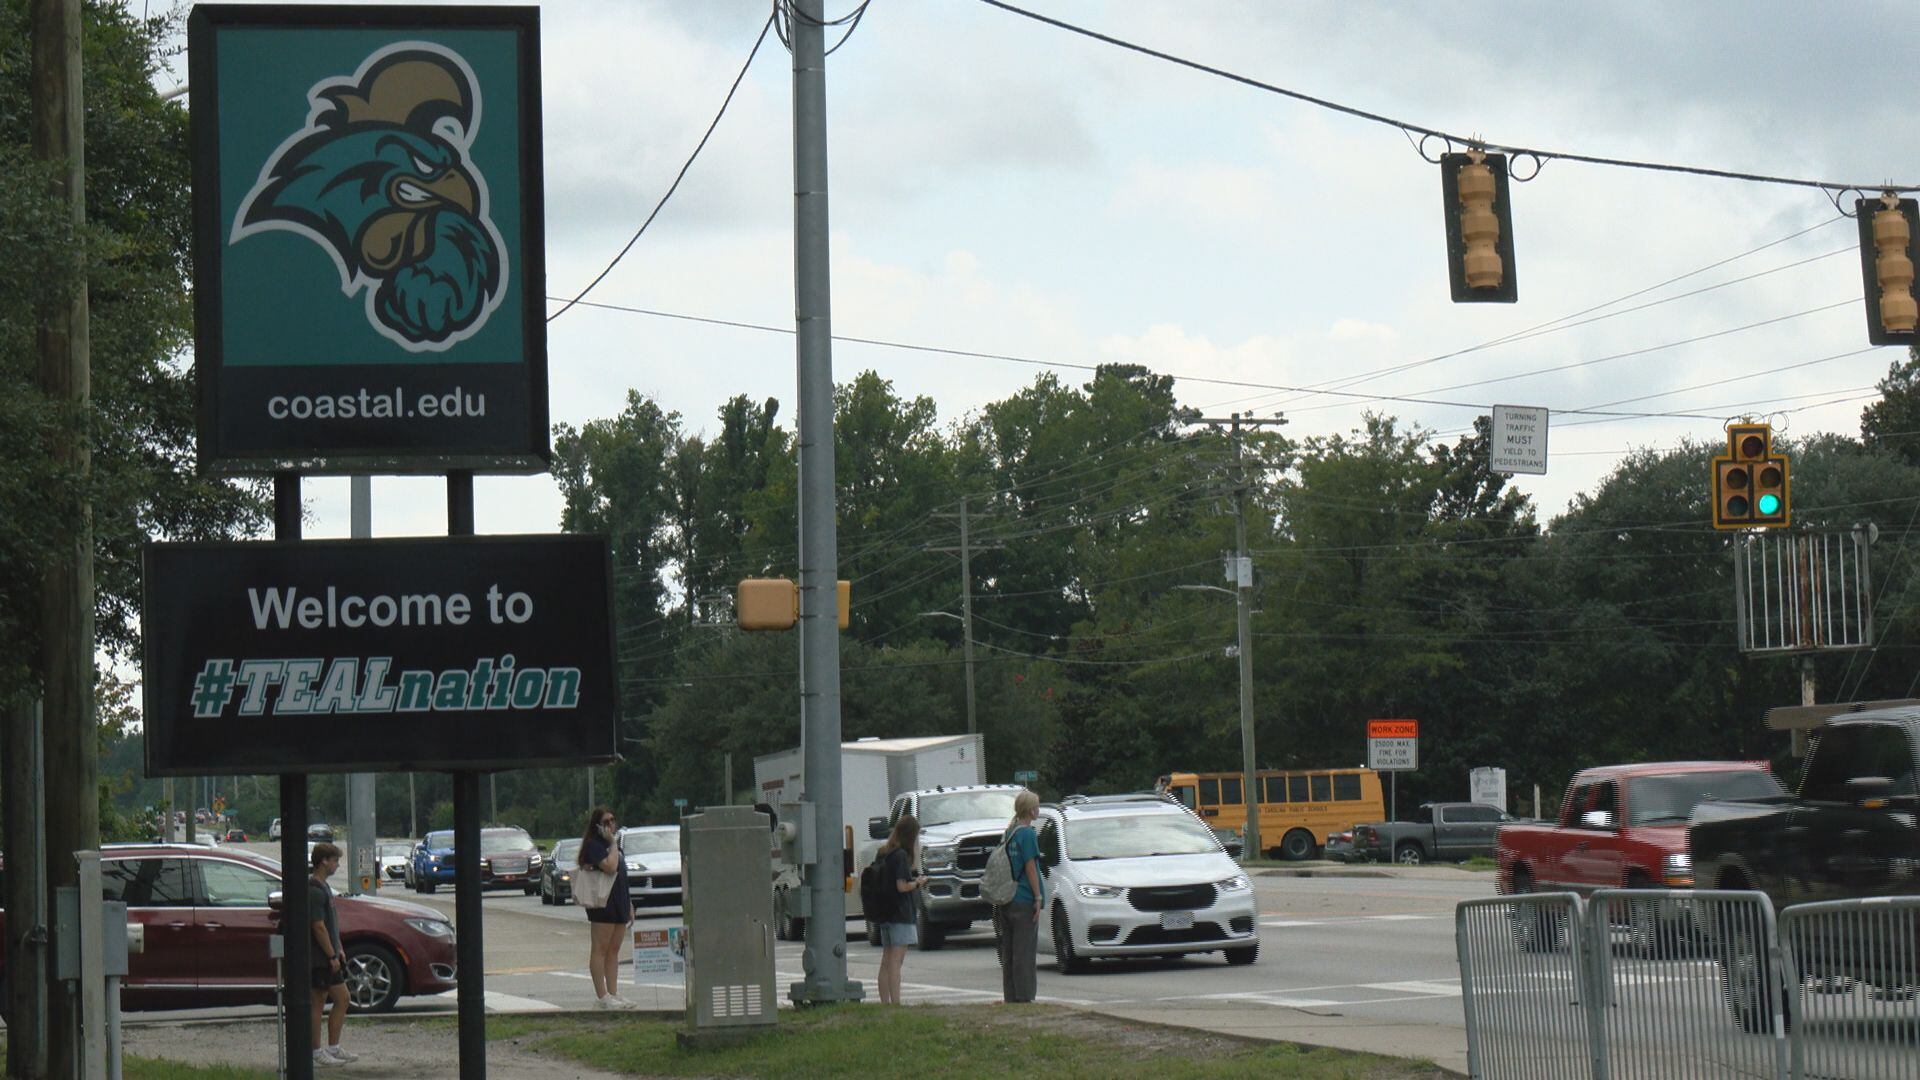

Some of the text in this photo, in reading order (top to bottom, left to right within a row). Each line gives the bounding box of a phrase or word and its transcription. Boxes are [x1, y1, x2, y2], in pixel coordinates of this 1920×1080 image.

[268, 387, 486, 419] coastal.edu
[1505, 412, 1537, 421] TURNING
[1505, 423, 1536, 432] TRAFFIC
[1507, 435, 1532, 444] MUST
[1503, 448, 1523, 456] YIELD
[1494, 458, 1544, 468] PEDESTRIANS
[248, 583, 533, 630] Welcome to
[190, 653, 581, 718] #TEALnation
[1372, 726, 1414, 734] WORK ZONE
